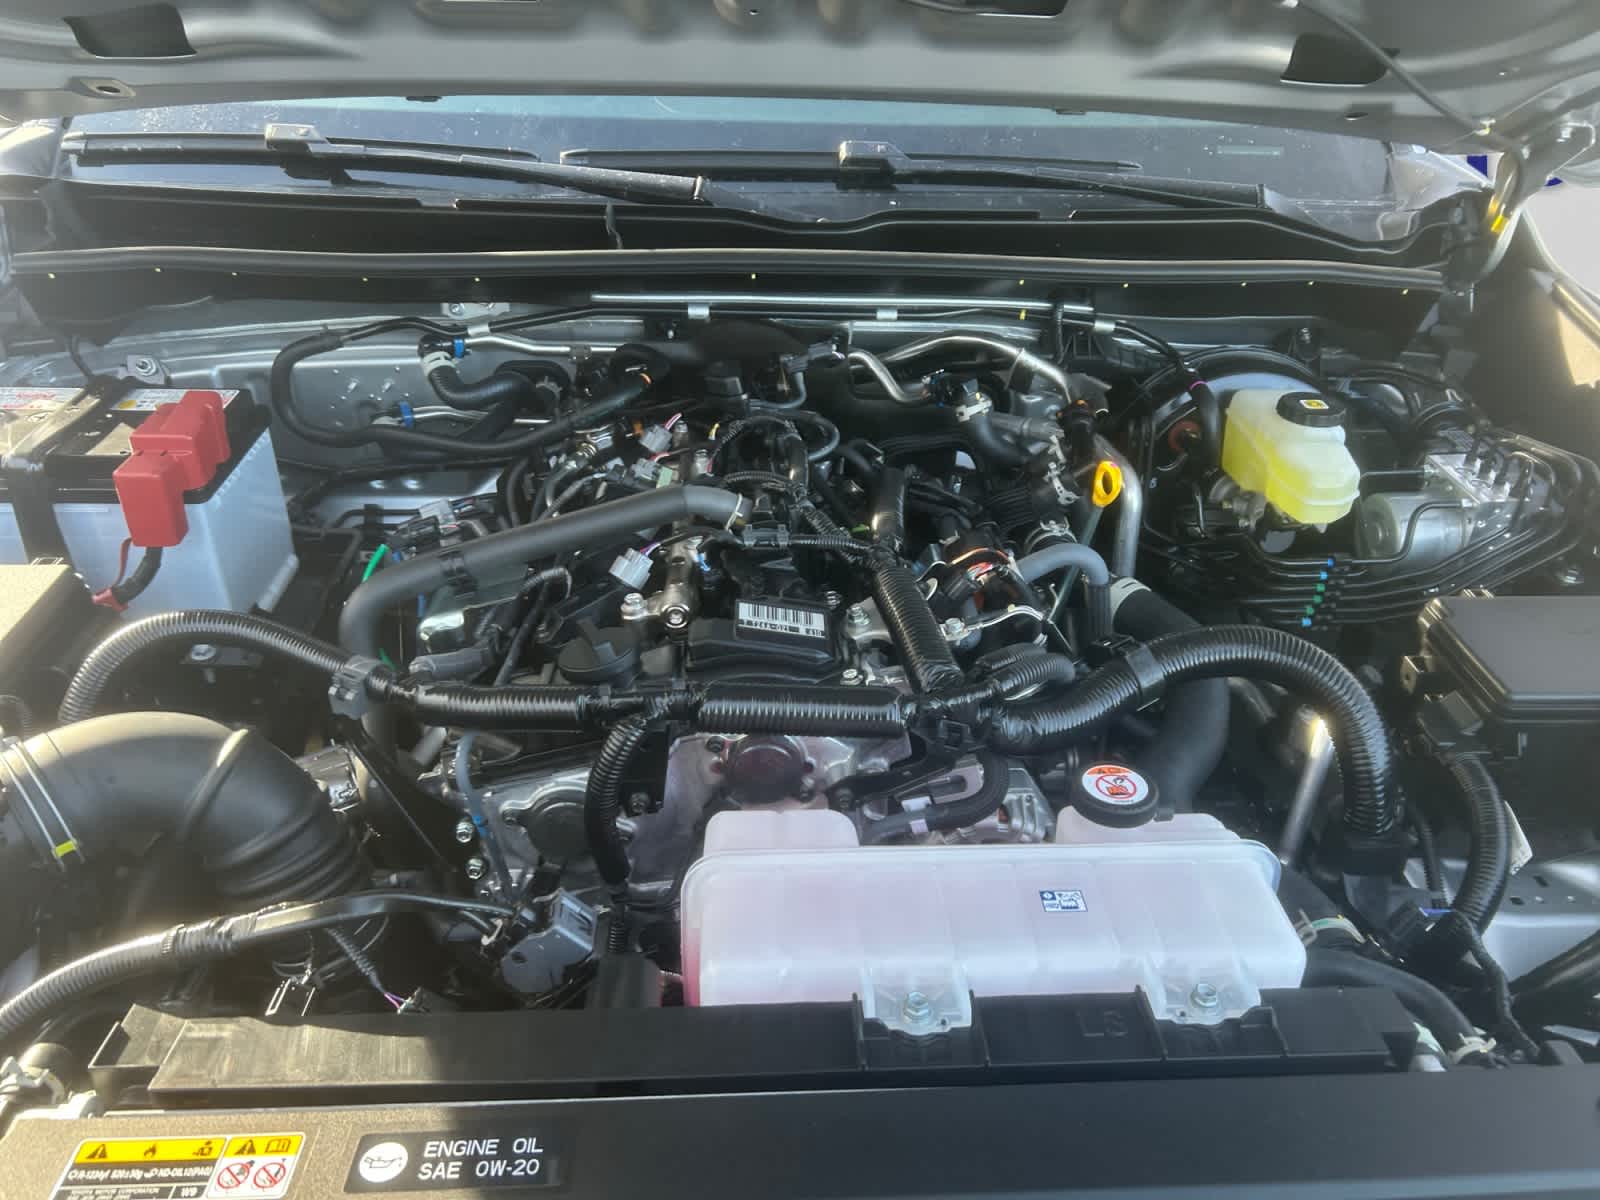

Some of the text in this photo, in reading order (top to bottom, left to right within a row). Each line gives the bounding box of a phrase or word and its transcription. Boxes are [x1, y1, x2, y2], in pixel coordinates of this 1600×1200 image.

[424, 1137, 543, 1157] ENGINE OIL
[418, 1158, 540, 1180] SAE 0W-20
